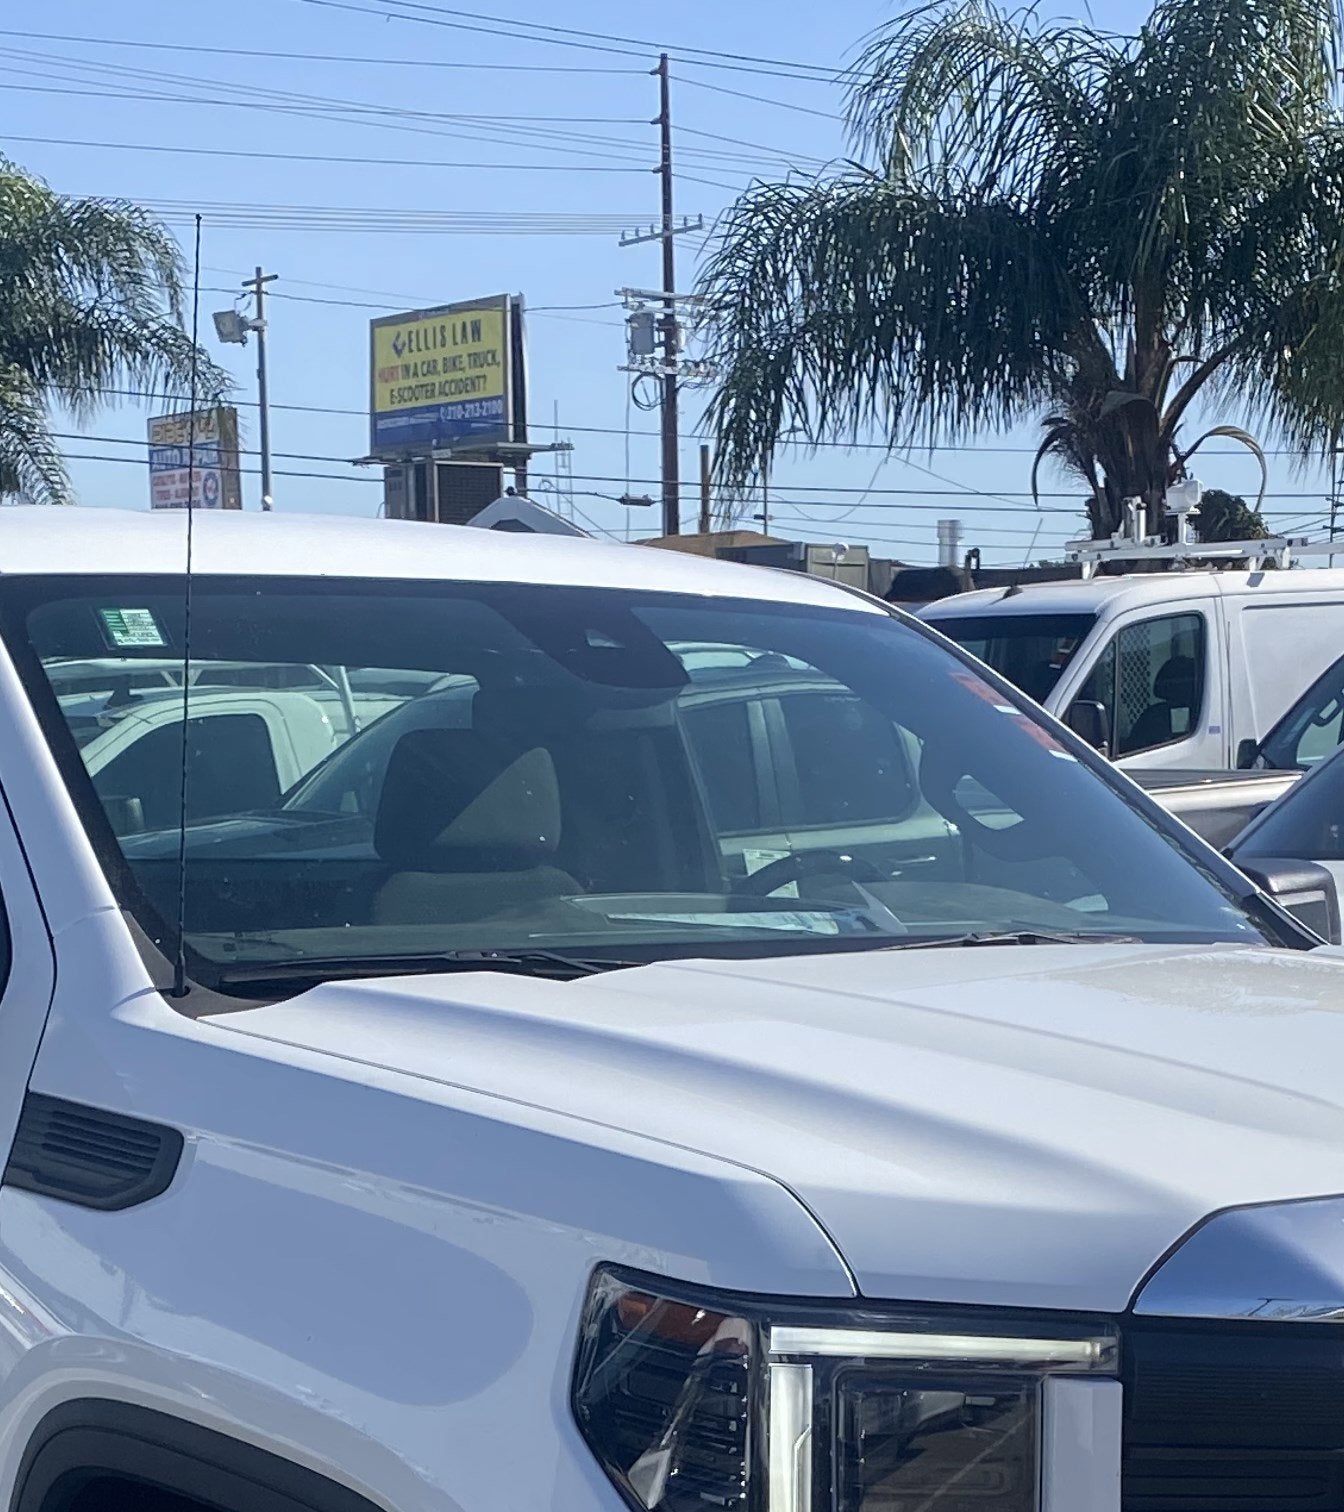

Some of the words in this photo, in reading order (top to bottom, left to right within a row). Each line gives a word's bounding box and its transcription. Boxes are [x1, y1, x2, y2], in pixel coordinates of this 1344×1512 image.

[408, 324, 446, 353] ELLIS
[452, 319, 482, 345] LAW
[389, 382, 436, 405] E-SCOOTER
[438, 375, 488, 397] ACCIDENT?
